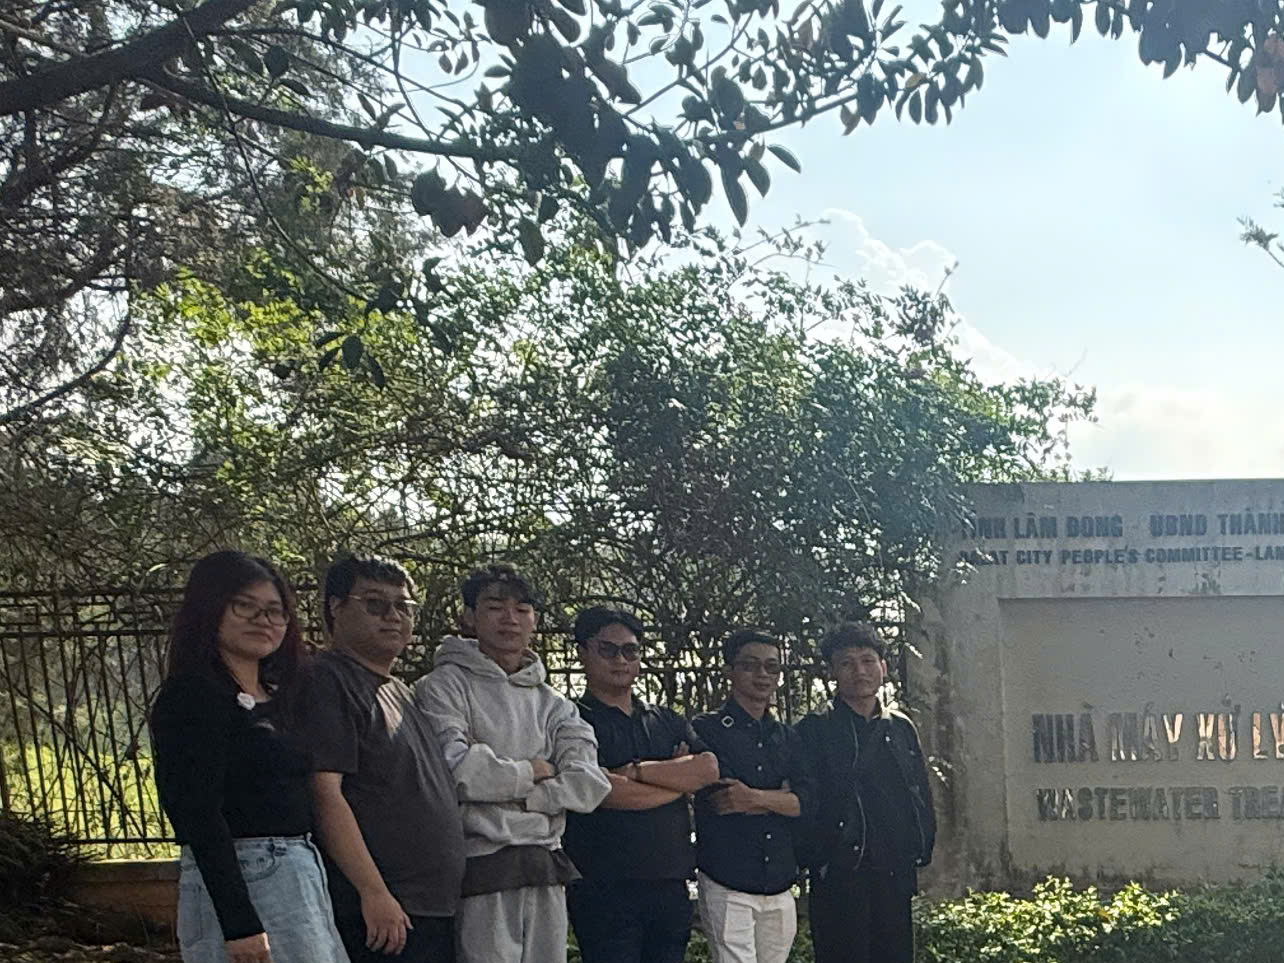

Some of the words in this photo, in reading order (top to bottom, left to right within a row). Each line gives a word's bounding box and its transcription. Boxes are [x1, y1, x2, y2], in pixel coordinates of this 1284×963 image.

[1014, 512, 1057, 538] LÂM
[1150, 513, 1208, 537] UBND
[1016, 550, 1052, 565] CITY
[1032, 701, 1099, 763] NHÀ
[1111, 701, 1183, 762] MÁY
[1036, 787, 1220, 821] WASTEWATER
